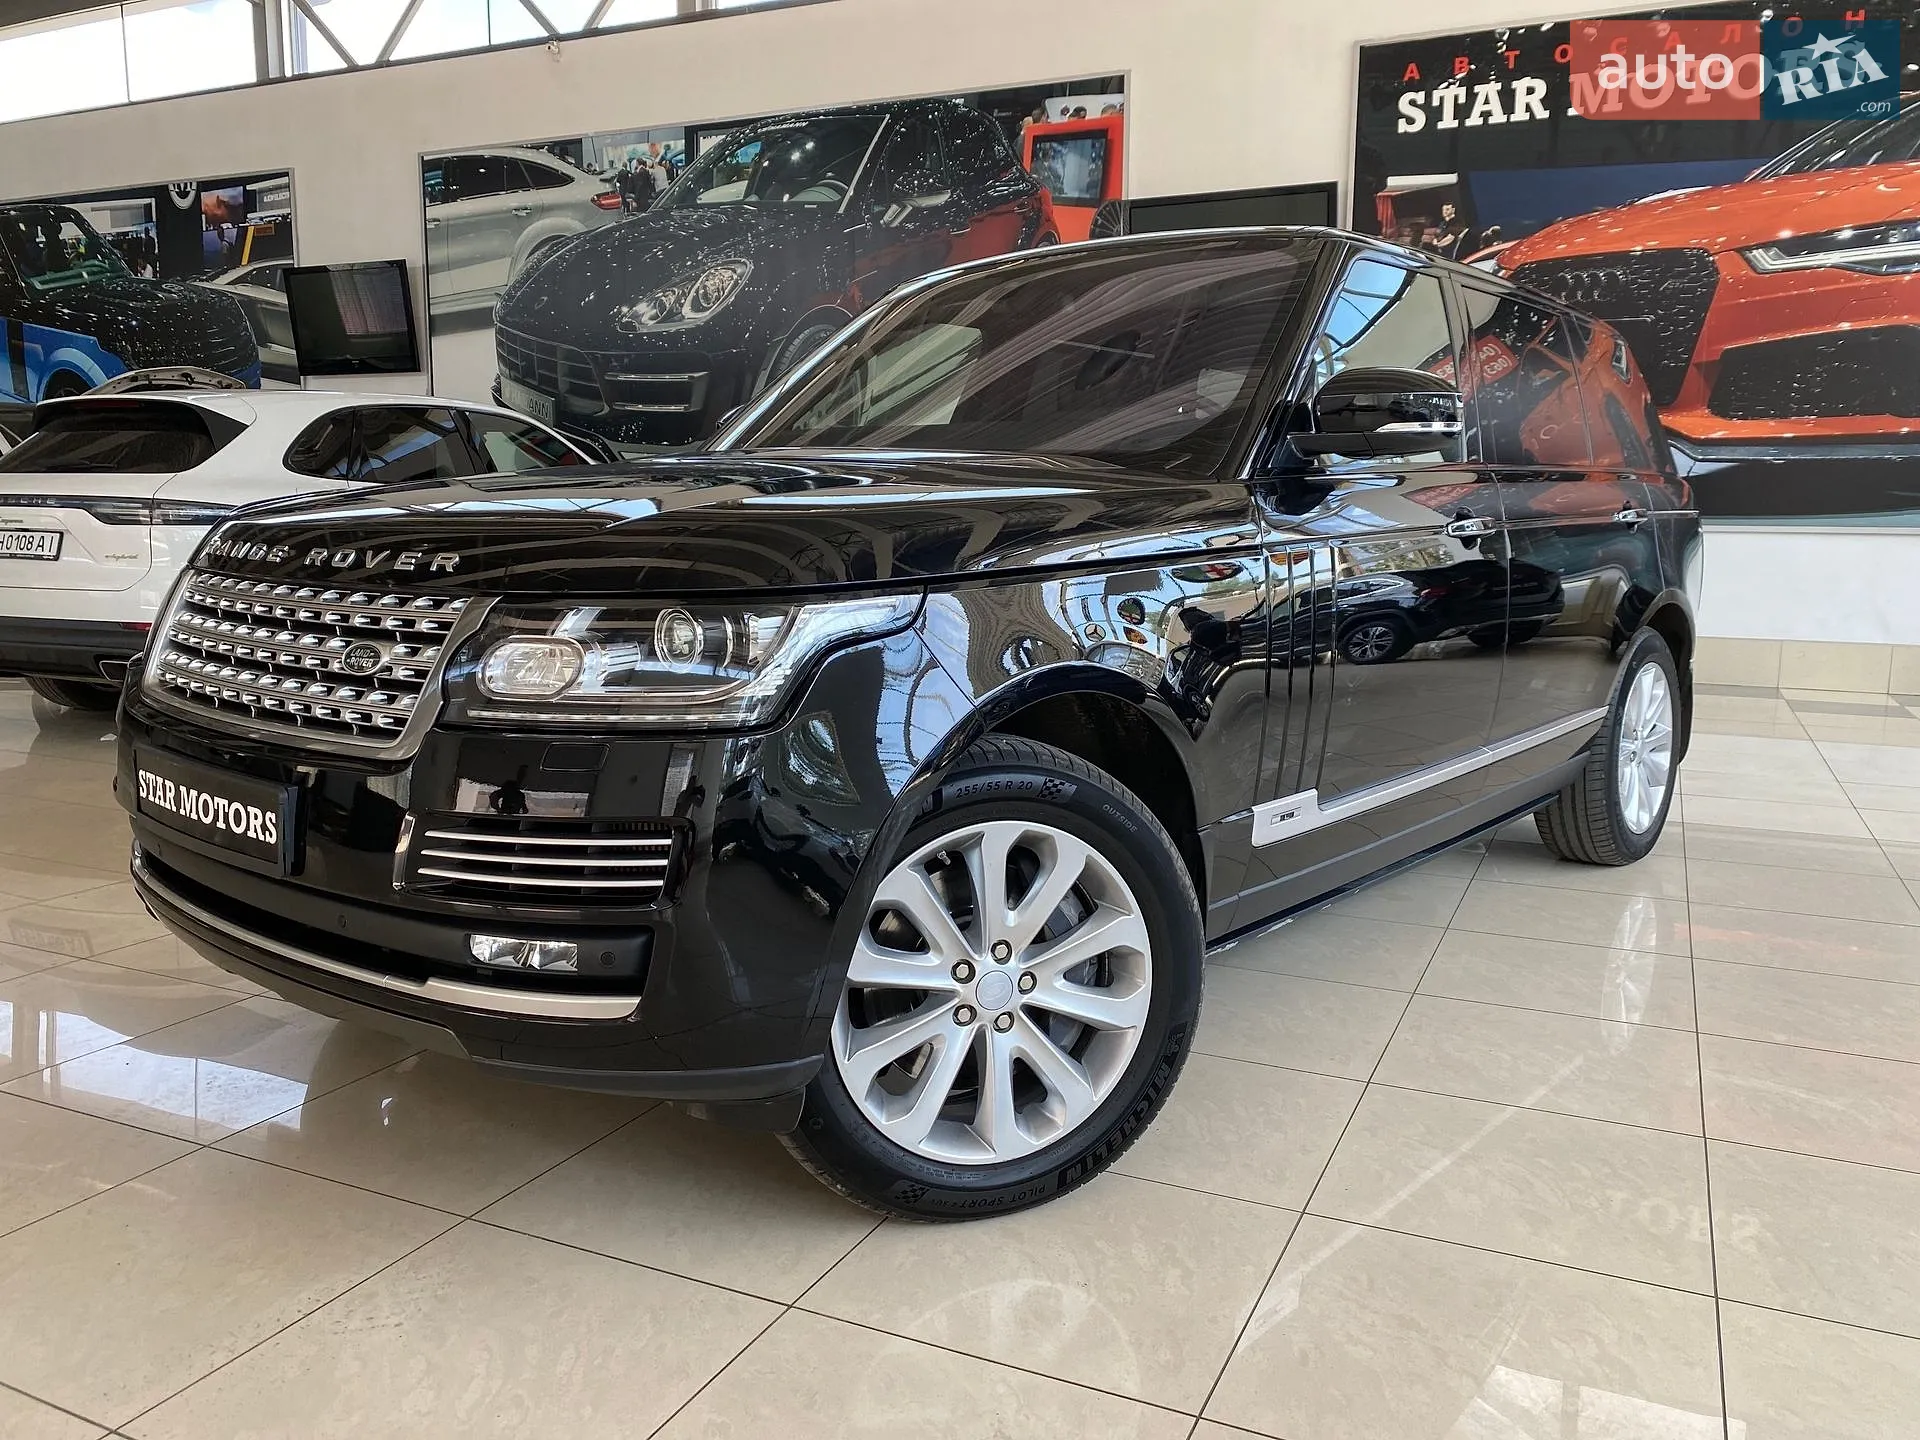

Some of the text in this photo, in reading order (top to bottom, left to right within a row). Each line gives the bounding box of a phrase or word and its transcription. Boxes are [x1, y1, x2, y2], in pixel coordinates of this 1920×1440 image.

[1396, 76, 1550, 134] STAR
[206, 535, 461, 573] RANGE ROVER
[138, 768, 278, 845] STAR MOTORS
[956, 780, 1033, 799] 255/55 R 20
[1102, 803, 1139, 834] OUTSIDE
[1065, 1063, 1172, 1186] MICHELIN
[958, 1194, 1007, 1209] SPORT
[1006, 1183, 1046, 1205] PILOT
